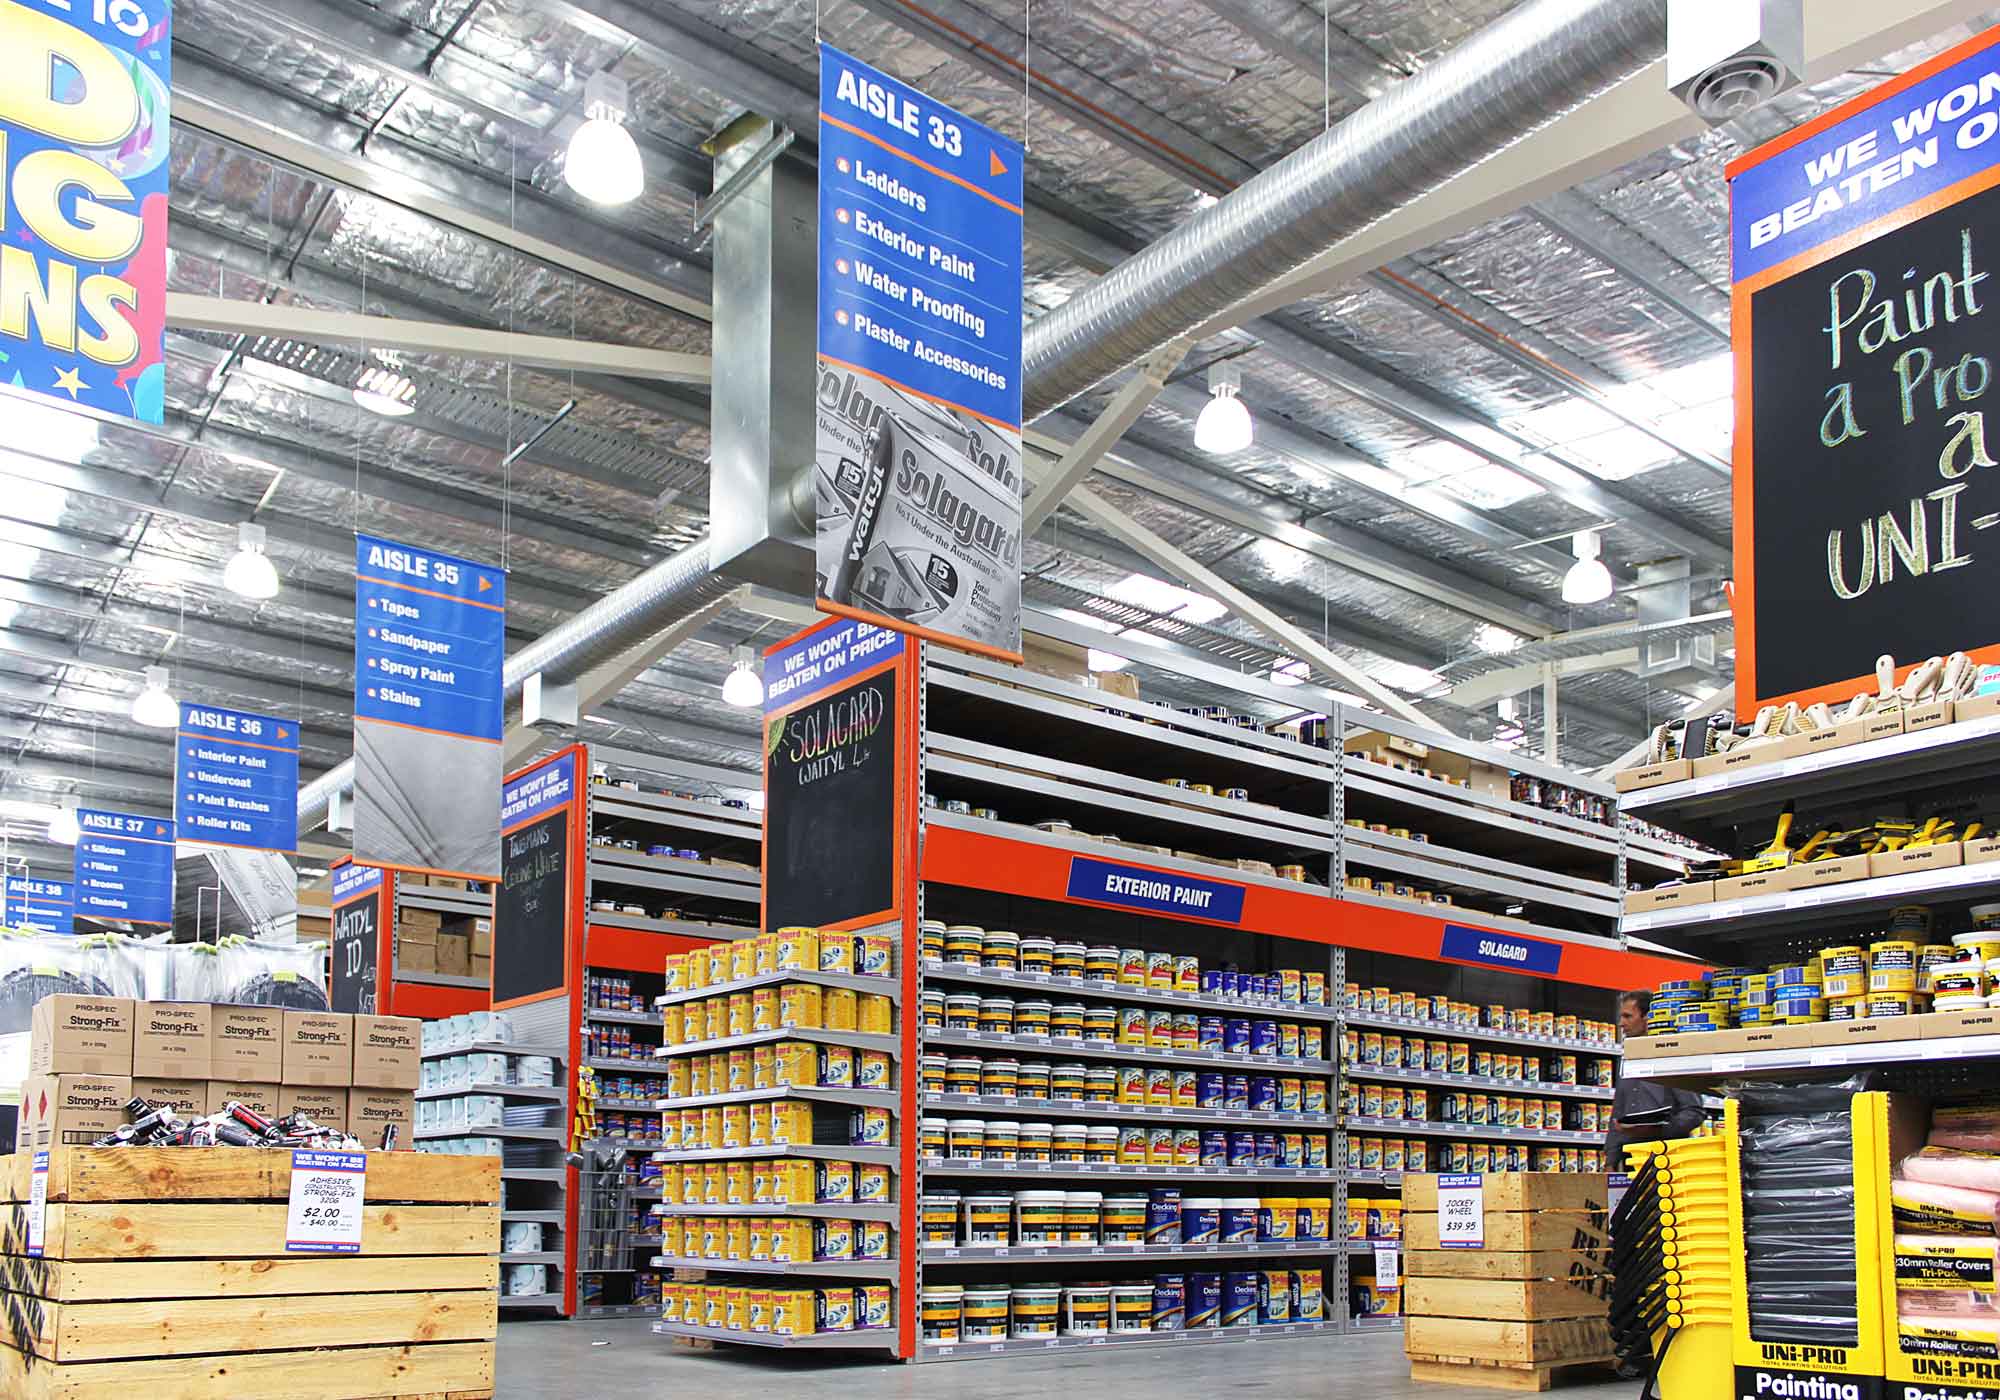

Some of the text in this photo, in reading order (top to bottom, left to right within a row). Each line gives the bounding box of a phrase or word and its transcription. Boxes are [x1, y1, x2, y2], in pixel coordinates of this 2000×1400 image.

[836, 69, 963, 158] AISLE 33
[1804, 129, 1878, 187] WE
[855, 160, 927, 212] Ladders
[1750, 135, 1938, 250] BEATEN
[855, 210, 976, 283] Exterior Paint
[854, 261, 985, 338] Water Proofing
[1822, 228, 1990, 370] Paint
[854, 313, 1006, 391] Plaster Accessories
[1892, 346, 1992, 426] Pro
[818, 417, 846, 444] Under
[841, 460, 861, 484] 15
[896, 447, 1020, 568] Solagard
[368, 546, 459, 585] AISLE 35
[931, 556, 950, 580] 15
[380, 598, 420, 619] Tapes
[380, 628, 451, 655] Sandpaper
[784, 653, 805, 673] WE
[808, 627, 854, 662] WON'T
[380, 658, 455, 685] Spray Paint
[768, 629, 896, 699] BEATEN ON PRICE
[380, 687, 421, 708] Stains
[188, 710, 262, 736] AISLE 36
[198, 748, 267, 769] Interior Paint
[197, 771, 252, 788] Undercoat
[506, 788, 519, 804] WE
[528, 791, 541, 807] ON
[543, 778, 569, 801] PRICE
[197, 793, 270, 812] Paint Brushes
[83, 814, 144, 833] AISLE 37
[197, 815, 252, 832] Roller Kits
[1105, 874, 1213, 908] EXTERIOR PAINT
[1478, 940, 1527, 961] SOLAGARD
[75, 1004, 118, 1013] PRO-SPEC
[155, 1010, 196, 1018] PRO-SPEC
[70, 1015, 120, 1028] Strong-Fix
[151, 1021, 198, 1033] Strong-Fix
[229, 1015, 268, 1023] PRO-SPEC
[302, 1020, 338, 1028] PRO-SPEC
[224, 1025, 270, 1037] Strong-Fix
[297, 1031, 340, 1042] Strong-Fix
[369, 1034, 410, 1046] Strong-Fix
[72, 1084, 115, 1092] PRO-SPEC
[226, 1091, 263, 1099] PRO-SPEC
[67, 1095, 118, 1107] Strong-Fix
[368, 1097, 401, 1105] PRO-SPEC
[292, 1106, 335, 1117] Strong-Fix
[363, 1107, 403, 1118] Strong-Fix
[296, 1153, 313, 1161] WE
[315, 1154, 348, 1163] WON'T
[310, 1177, 353, 1185] ADHESIVE
[304, 1190, 356, 1198] STRONG-FIX
[1446, 1199, 1475, 1207] JOCKEY
[303, 1207, 340, 1218] $2.00
[1152, 1203, 1177, 1212] Decking
[1446, 1221, 1476, 1231] $39.95
[1955, 1260, 1991, 1271] Covers
[1930, 1340, 1959, 1350] Roller
[1756, 1372, 1859, 1400] Painting
